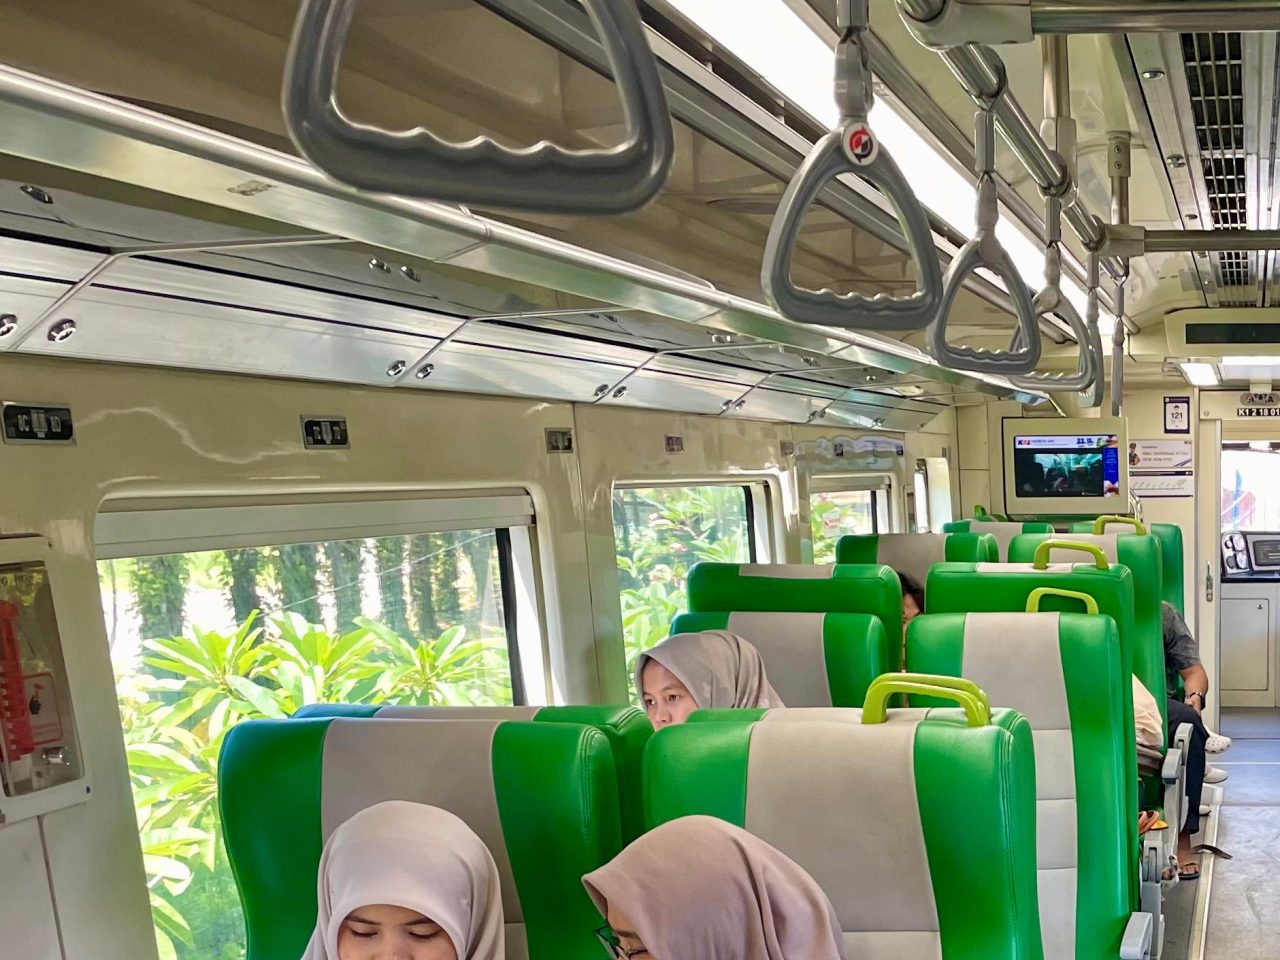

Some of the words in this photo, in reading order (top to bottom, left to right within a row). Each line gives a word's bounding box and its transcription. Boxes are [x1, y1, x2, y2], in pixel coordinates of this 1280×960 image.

[1171, 411, 1183, 419] 121
[1251, 408, 1257, 416] 2
[1260, 408, 1268, 416] 18
[1270, 408, 1280, 416] 01
